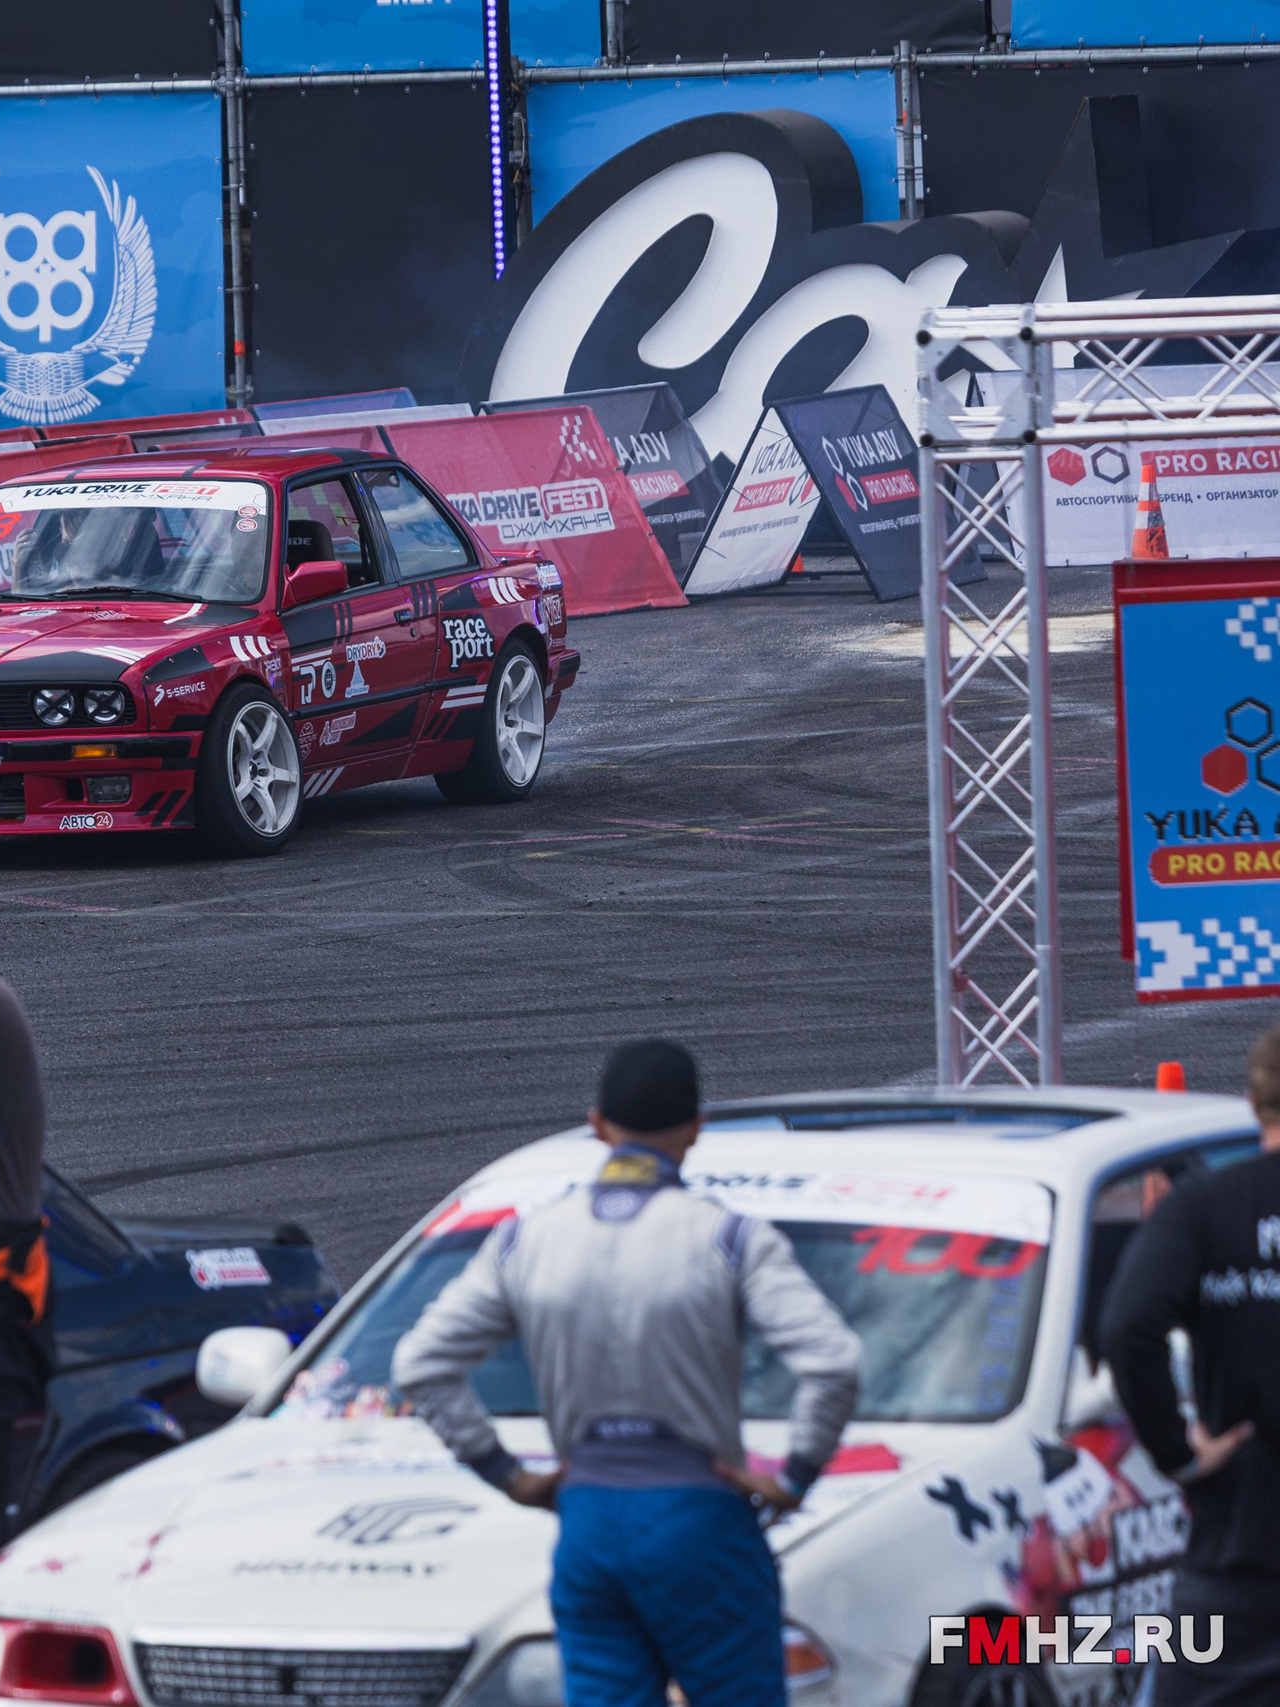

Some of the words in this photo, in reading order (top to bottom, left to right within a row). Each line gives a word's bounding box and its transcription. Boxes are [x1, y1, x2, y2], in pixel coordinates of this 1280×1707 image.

[630, 431, 671, 464] ADV
[837, 431, 877, 468] YUKA
[872, 428, 904, 462] ADV
[1155, 453, 1208, 474] PRO
[1215, 449, 1280, 471] RACI
[23, 485, 78, 498] YUKA
[79, 484, 152, 494] DRIVE
[629, 474, 679, 497] RACING
[865, 480, 887, 501] PRO
[883, 473, 916, 497] RACING
[1056, 491, 1140, 507] АВТОСПОРТИВН
[1206, 488, 1280, 502] ОРГАНИЗАТОР
[482, 491, 542, 521] DRIVE
[545, 486, 600, 513] FEST
[501, 512, 613, 539] ДЖИМХАНА
[443, 618, 487, 638] race
[346, 642, 377, 662] DRYDRY
[450, 634, 494, 668] port
[166, 681, 207, 698] S-SERVICE
[1145, 807, 1261, 844] YUKA
[1168, 853, 1226, 876] PRO
[851, 1225, 1044, 1280] 100
